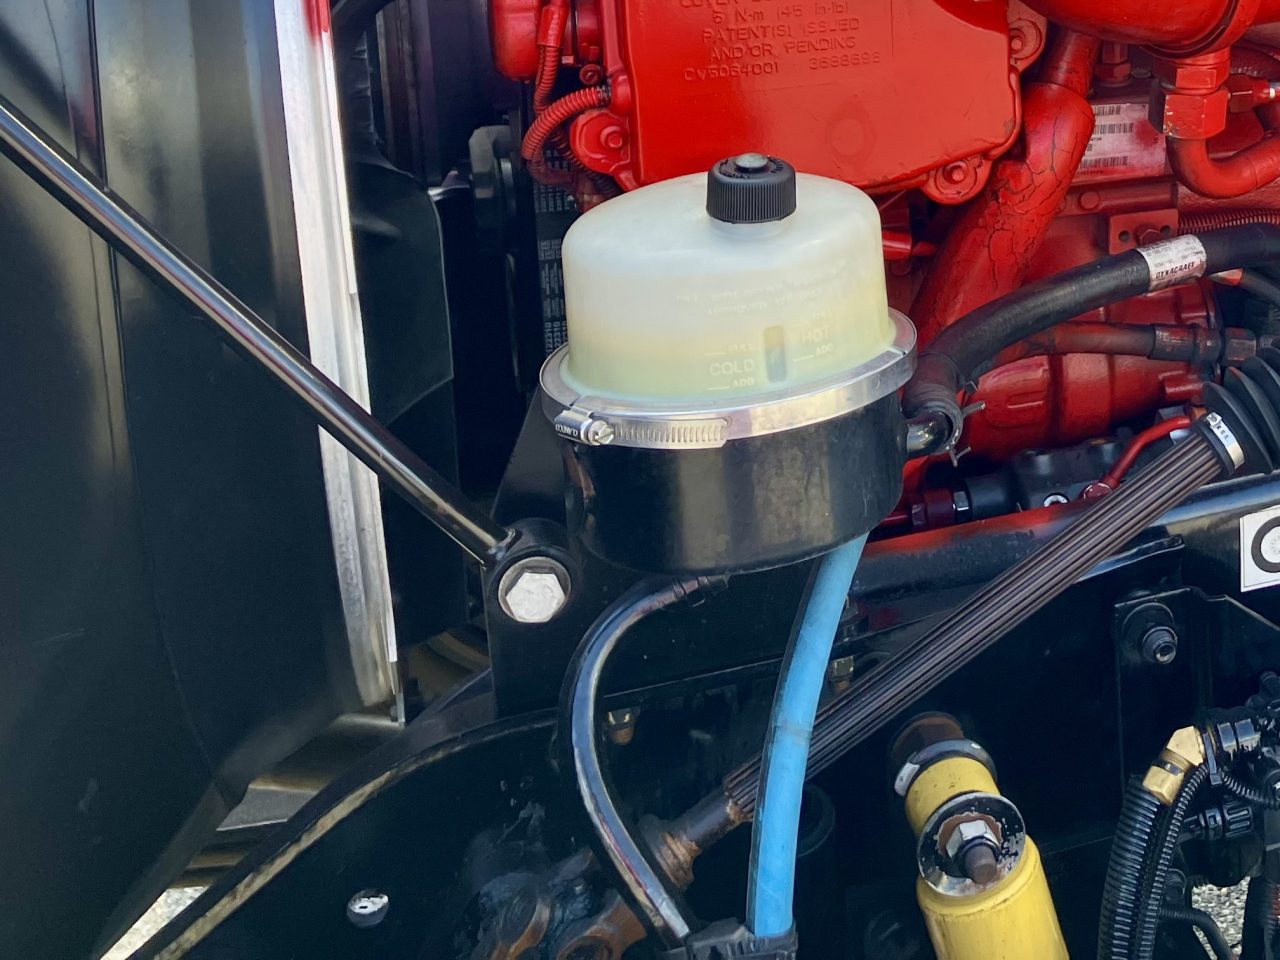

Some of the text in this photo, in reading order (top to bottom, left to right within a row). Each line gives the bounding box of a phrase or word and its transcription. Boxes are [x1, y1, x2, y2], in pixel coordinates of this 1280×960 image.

[784, 36, 857, 54] PENDING
[1156, 261, 1195, 280] DYNACRAFT
[709, 359, 755, 376] COLD
